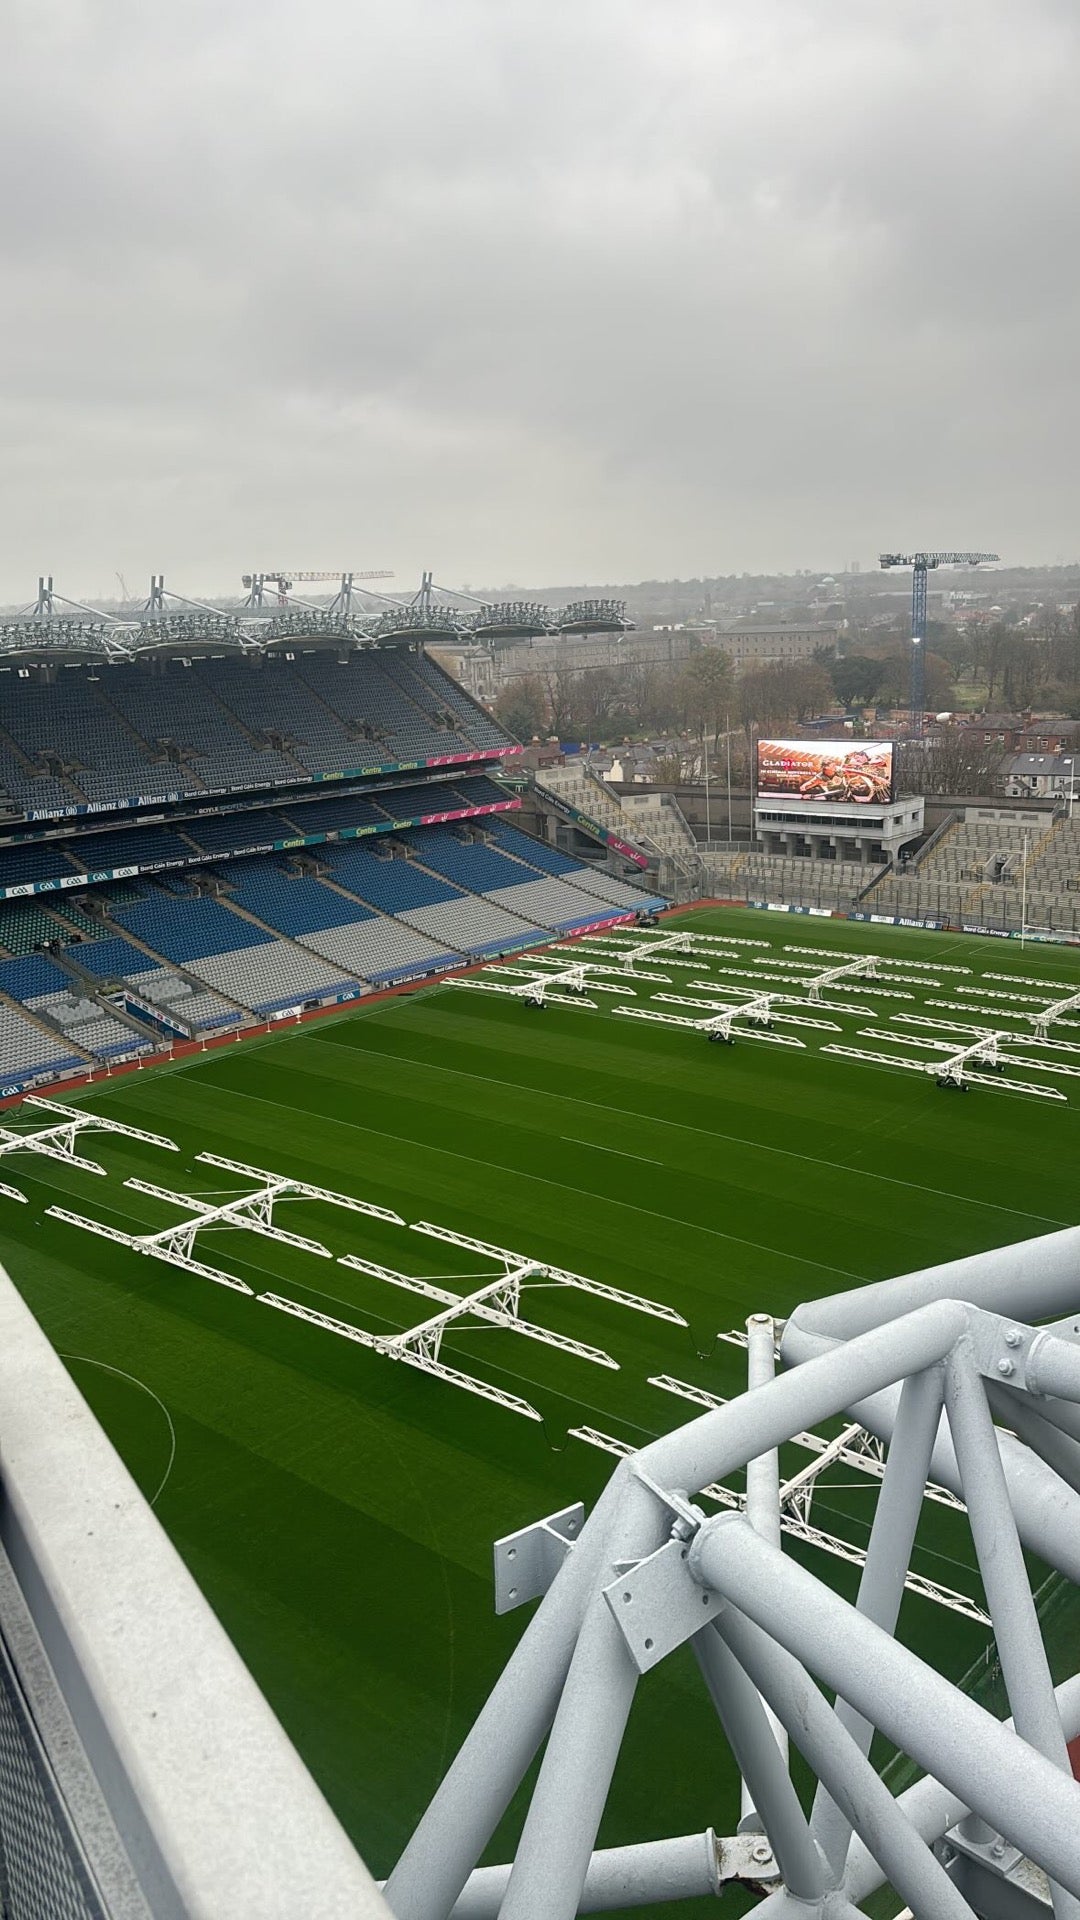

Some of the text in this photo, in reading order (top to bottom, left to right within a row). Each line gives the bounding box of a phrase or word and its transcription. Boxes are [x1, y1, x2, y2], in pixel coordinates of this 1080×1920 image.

[398, 762, 418, 770] Centra
[322, 771, 344, 780] Centra
[361, 767, 381, 775] Centra
[138, 794, 167, 806] Allianz
[87, 801, 117, 813] Allianz
[32, 809, 65, 821] Allianz
[393, 820, 412, 829] Centra
[577, 815, 600, 835] Centra
[356, 825, 377, 836] Centra
[283, 838, 305, 848] Centra
[118, 868, 133, 876] GAA
[93, 873, 108, 881] GAA
[39, 882, 55, 891] GAA
[66, 878, 82, 886] GAA
[12, 886, 28, 895] GAA
[342, 992, 355, 1000] GAA
[282, 1009, 294, 1017] GAA
[1, 1085, 19, 1096] GAA
